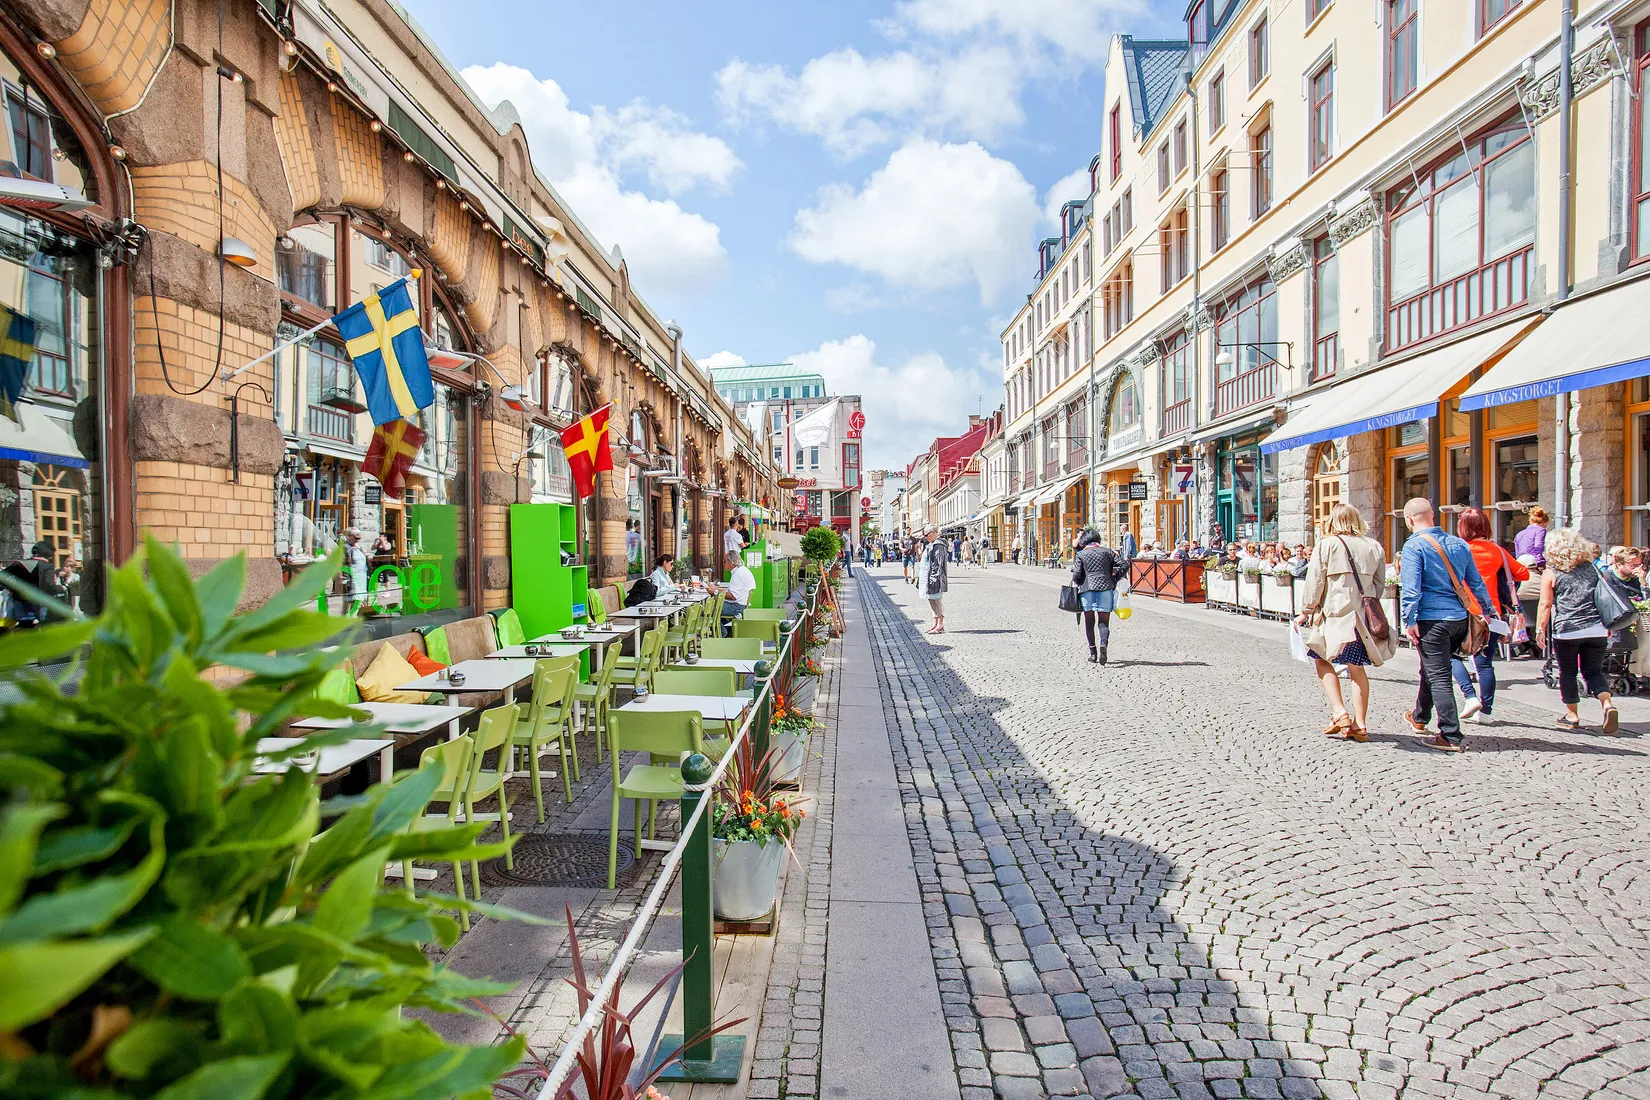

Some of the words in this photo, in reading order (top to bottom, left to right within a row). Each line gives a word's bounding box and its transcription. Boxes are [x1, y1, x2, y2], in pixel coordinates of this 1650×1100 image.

[512, 225, 534, 257] bee
[1484, 379, 1562, 407] KUNGSTORGET
[1367, 408, 1418, 430] KUNGSTORGET
[1175, 466, 1193, 493] 7
